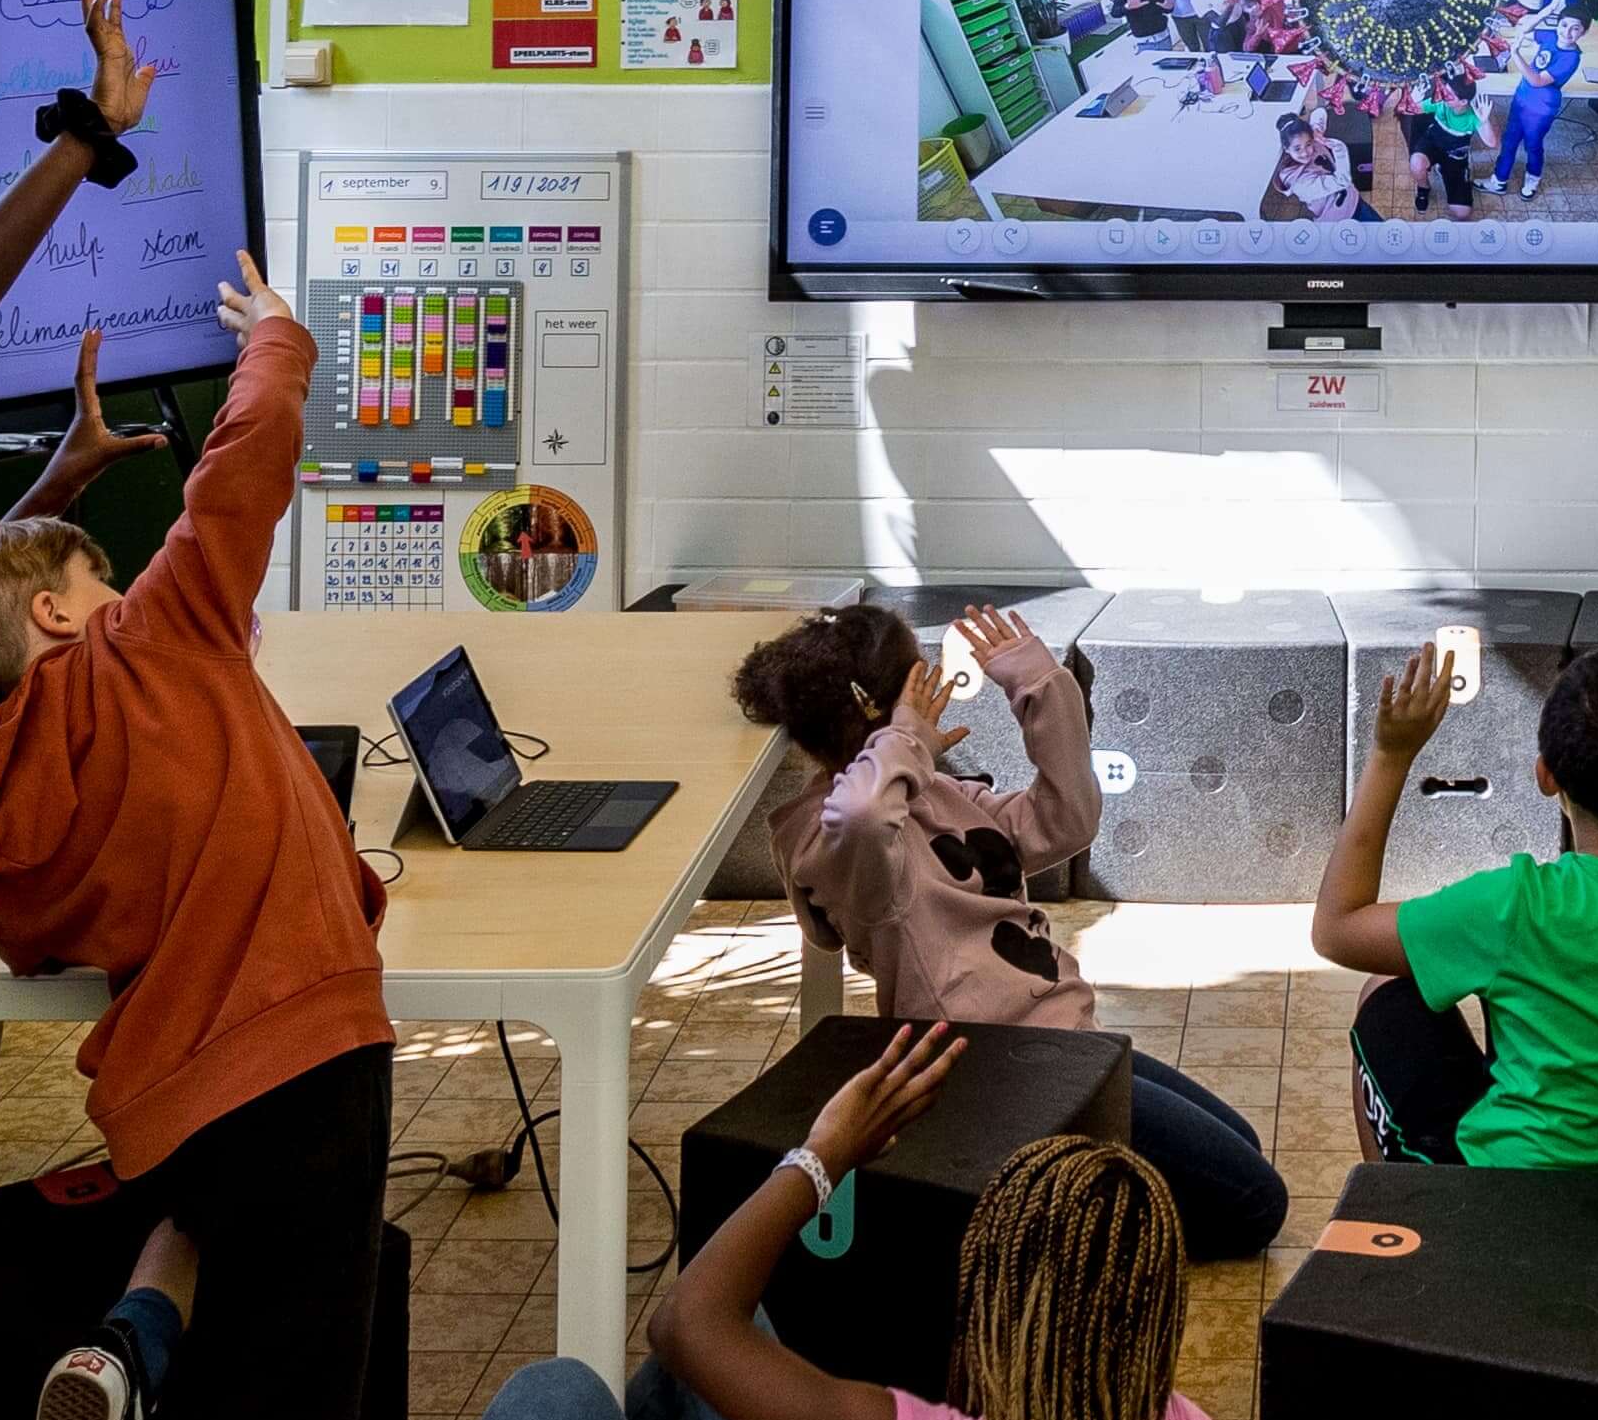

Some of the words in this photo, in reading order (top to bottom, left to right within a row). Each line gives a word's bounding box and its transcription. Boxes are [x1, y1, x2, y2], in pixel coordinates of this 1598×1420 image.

[122, 155, 202, 196] schade
[342, 177, 410, 189] september
[430, 180, 442, 190] 9.
[36, 222, 104, 276] hulp
[141, 229, 203, 262] storm
[545, 318, 562, 329] het
[566, 320, 597, 329] weer
[1308, 376, 1346, 394] ZW
